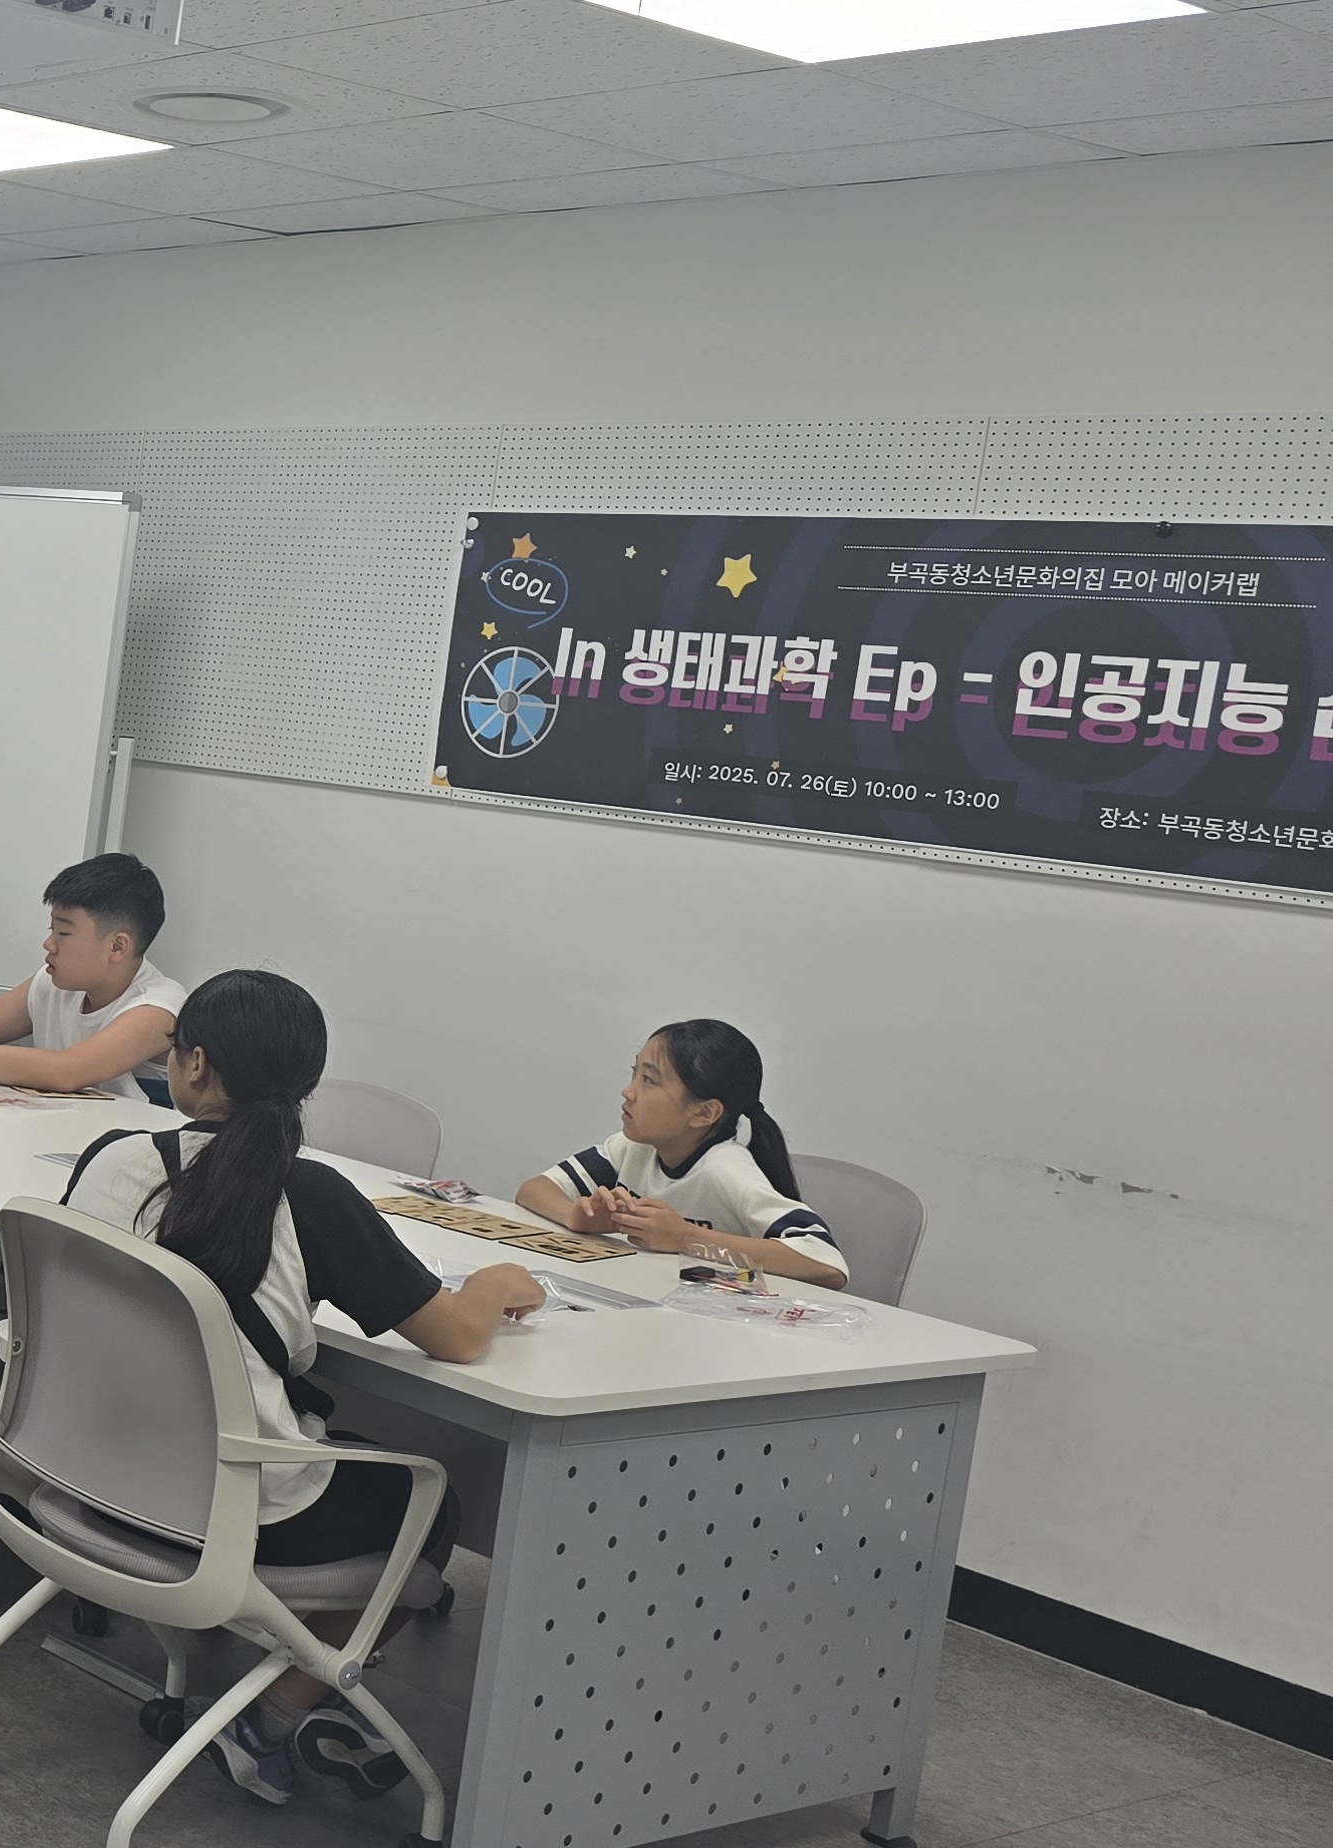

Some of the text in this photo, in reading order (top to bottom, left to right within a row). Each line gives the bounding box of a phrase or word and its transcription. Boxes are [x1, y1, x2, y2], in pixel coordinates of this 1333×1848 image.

[500, 568, 556, 605] COOL
[887, 561, 1261, 597] 부곡동청소년문화의집 모아 메이커랩
[554, 627, 607, 681] In
[621, 629, 838, 700] 생태과학
[853, 644, 937, 712] Ep
[1015, 651, 1289, 733] 인공지능
[664, 762, 703, 783] 일시:
[708, 765, 758, 785] 2025.
[766, 771, 793, 788] 07.
[800, 774, 857, 798] 26(토)
[864, 781, 917, 801] 10:00
[944, 789, 1000, 809] 13:00
[1099, 807, 1149, 829] 장소:
